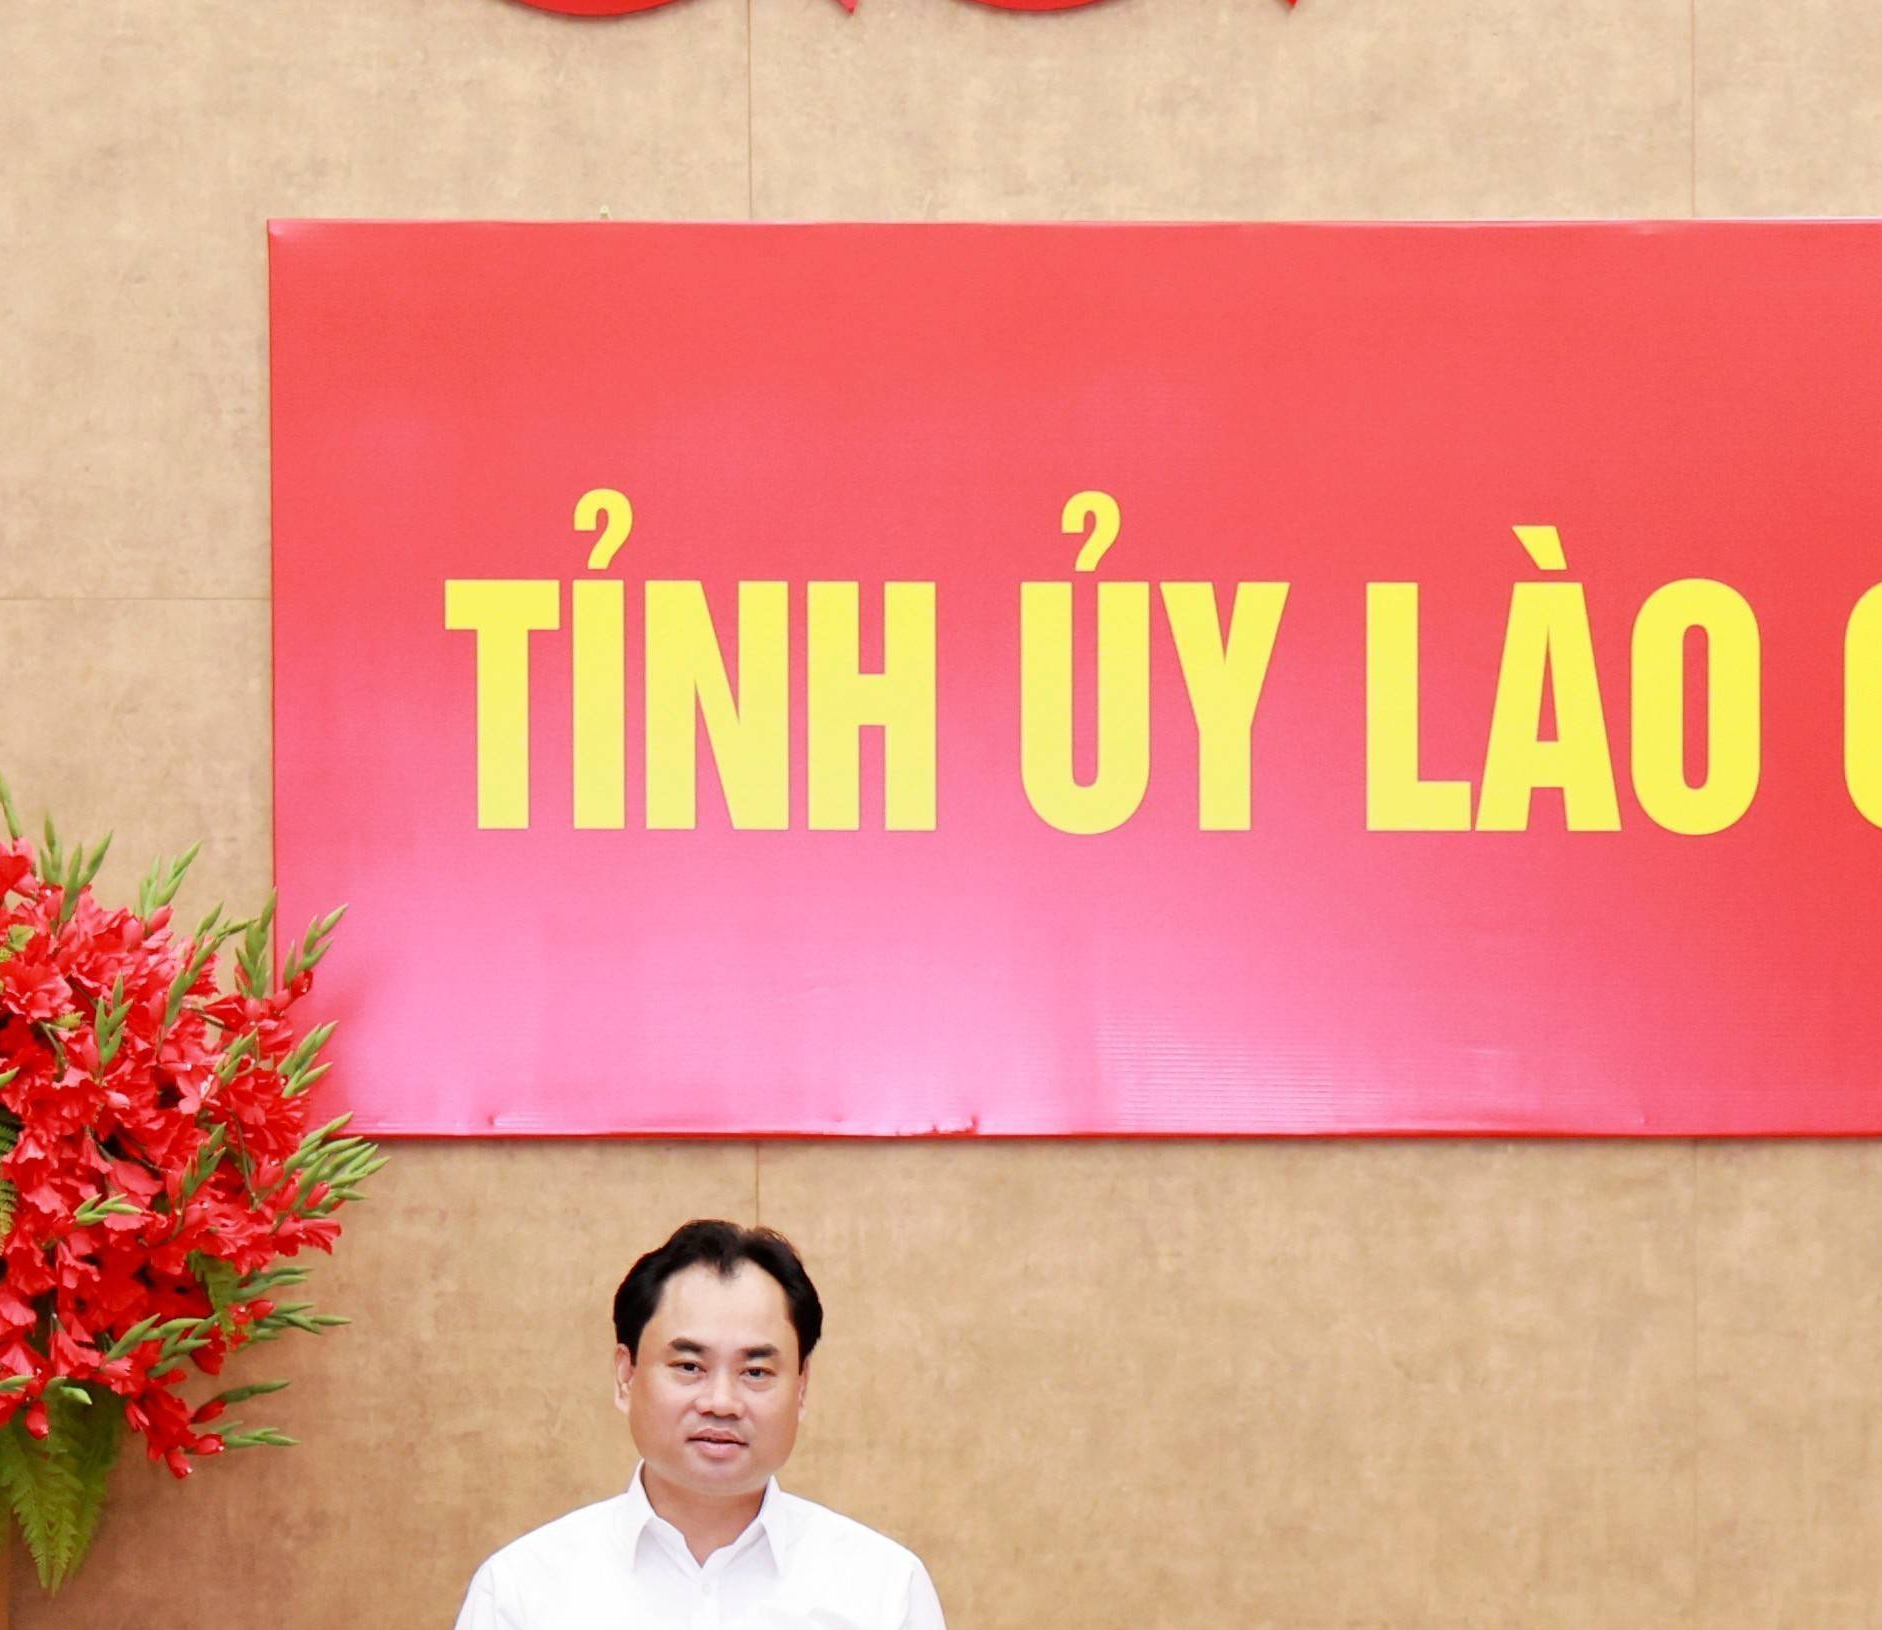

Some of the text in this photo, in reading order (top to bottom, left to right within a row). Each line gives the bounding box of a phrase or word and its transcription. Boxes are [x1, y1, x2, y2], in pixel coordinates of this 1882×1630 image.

[444, 487, 938, 829] TỈNH
[1019, 490, 1291, 833] ỦY
[1365, 524, 1762, 836] LÀO
